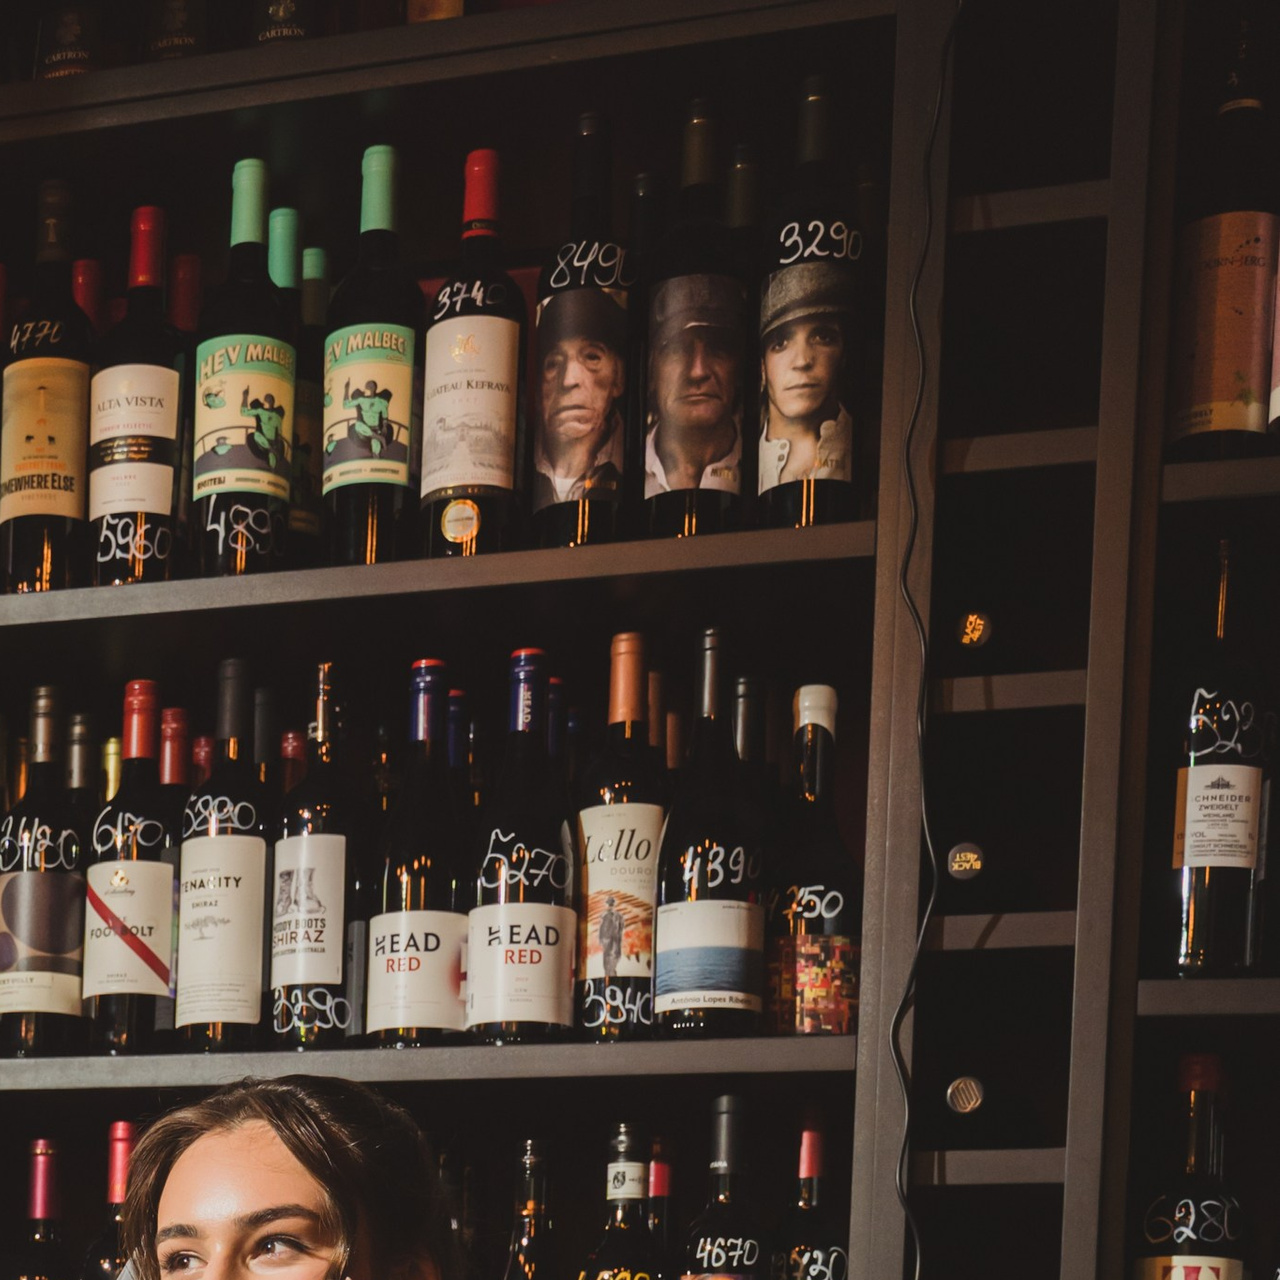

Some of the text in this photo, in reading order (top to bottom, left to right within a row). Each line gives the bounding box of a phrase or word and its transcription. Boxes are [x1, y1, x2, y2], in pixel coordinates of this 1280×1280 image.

[779, 220, 862, 264] 3290
[200, 343, 242, 380] HEY
[465, 380, 512, 395] KEFRAYA
[124, 396, 165, 411] VISTA
[51, 473, 75, 493] ELSE
[96, 515, 172, 563] 5960
[1198, 803, 1239, 812] ZWEIGELT
[584, 828, 652, 869] Lello
[954, 852, 979, 864] 4EST
[480, 829, 574, 889] 5270
[952, 858, 983, 871] BLACK
[610, 867, 654, 882] DOURO
[181, 876, 242, 894] TENACITY
[375, 932, 441, 957] HEAD
[488, 925, 561, 948] HEAD
[386, 956, 422, 974] RED
[505, 949, 542, 965] RED
[702, 994, 728, 1007] Lopes
[1145, 1195, 1241, 1244] 6280
[696, 1237, 760, 1269] 4670
